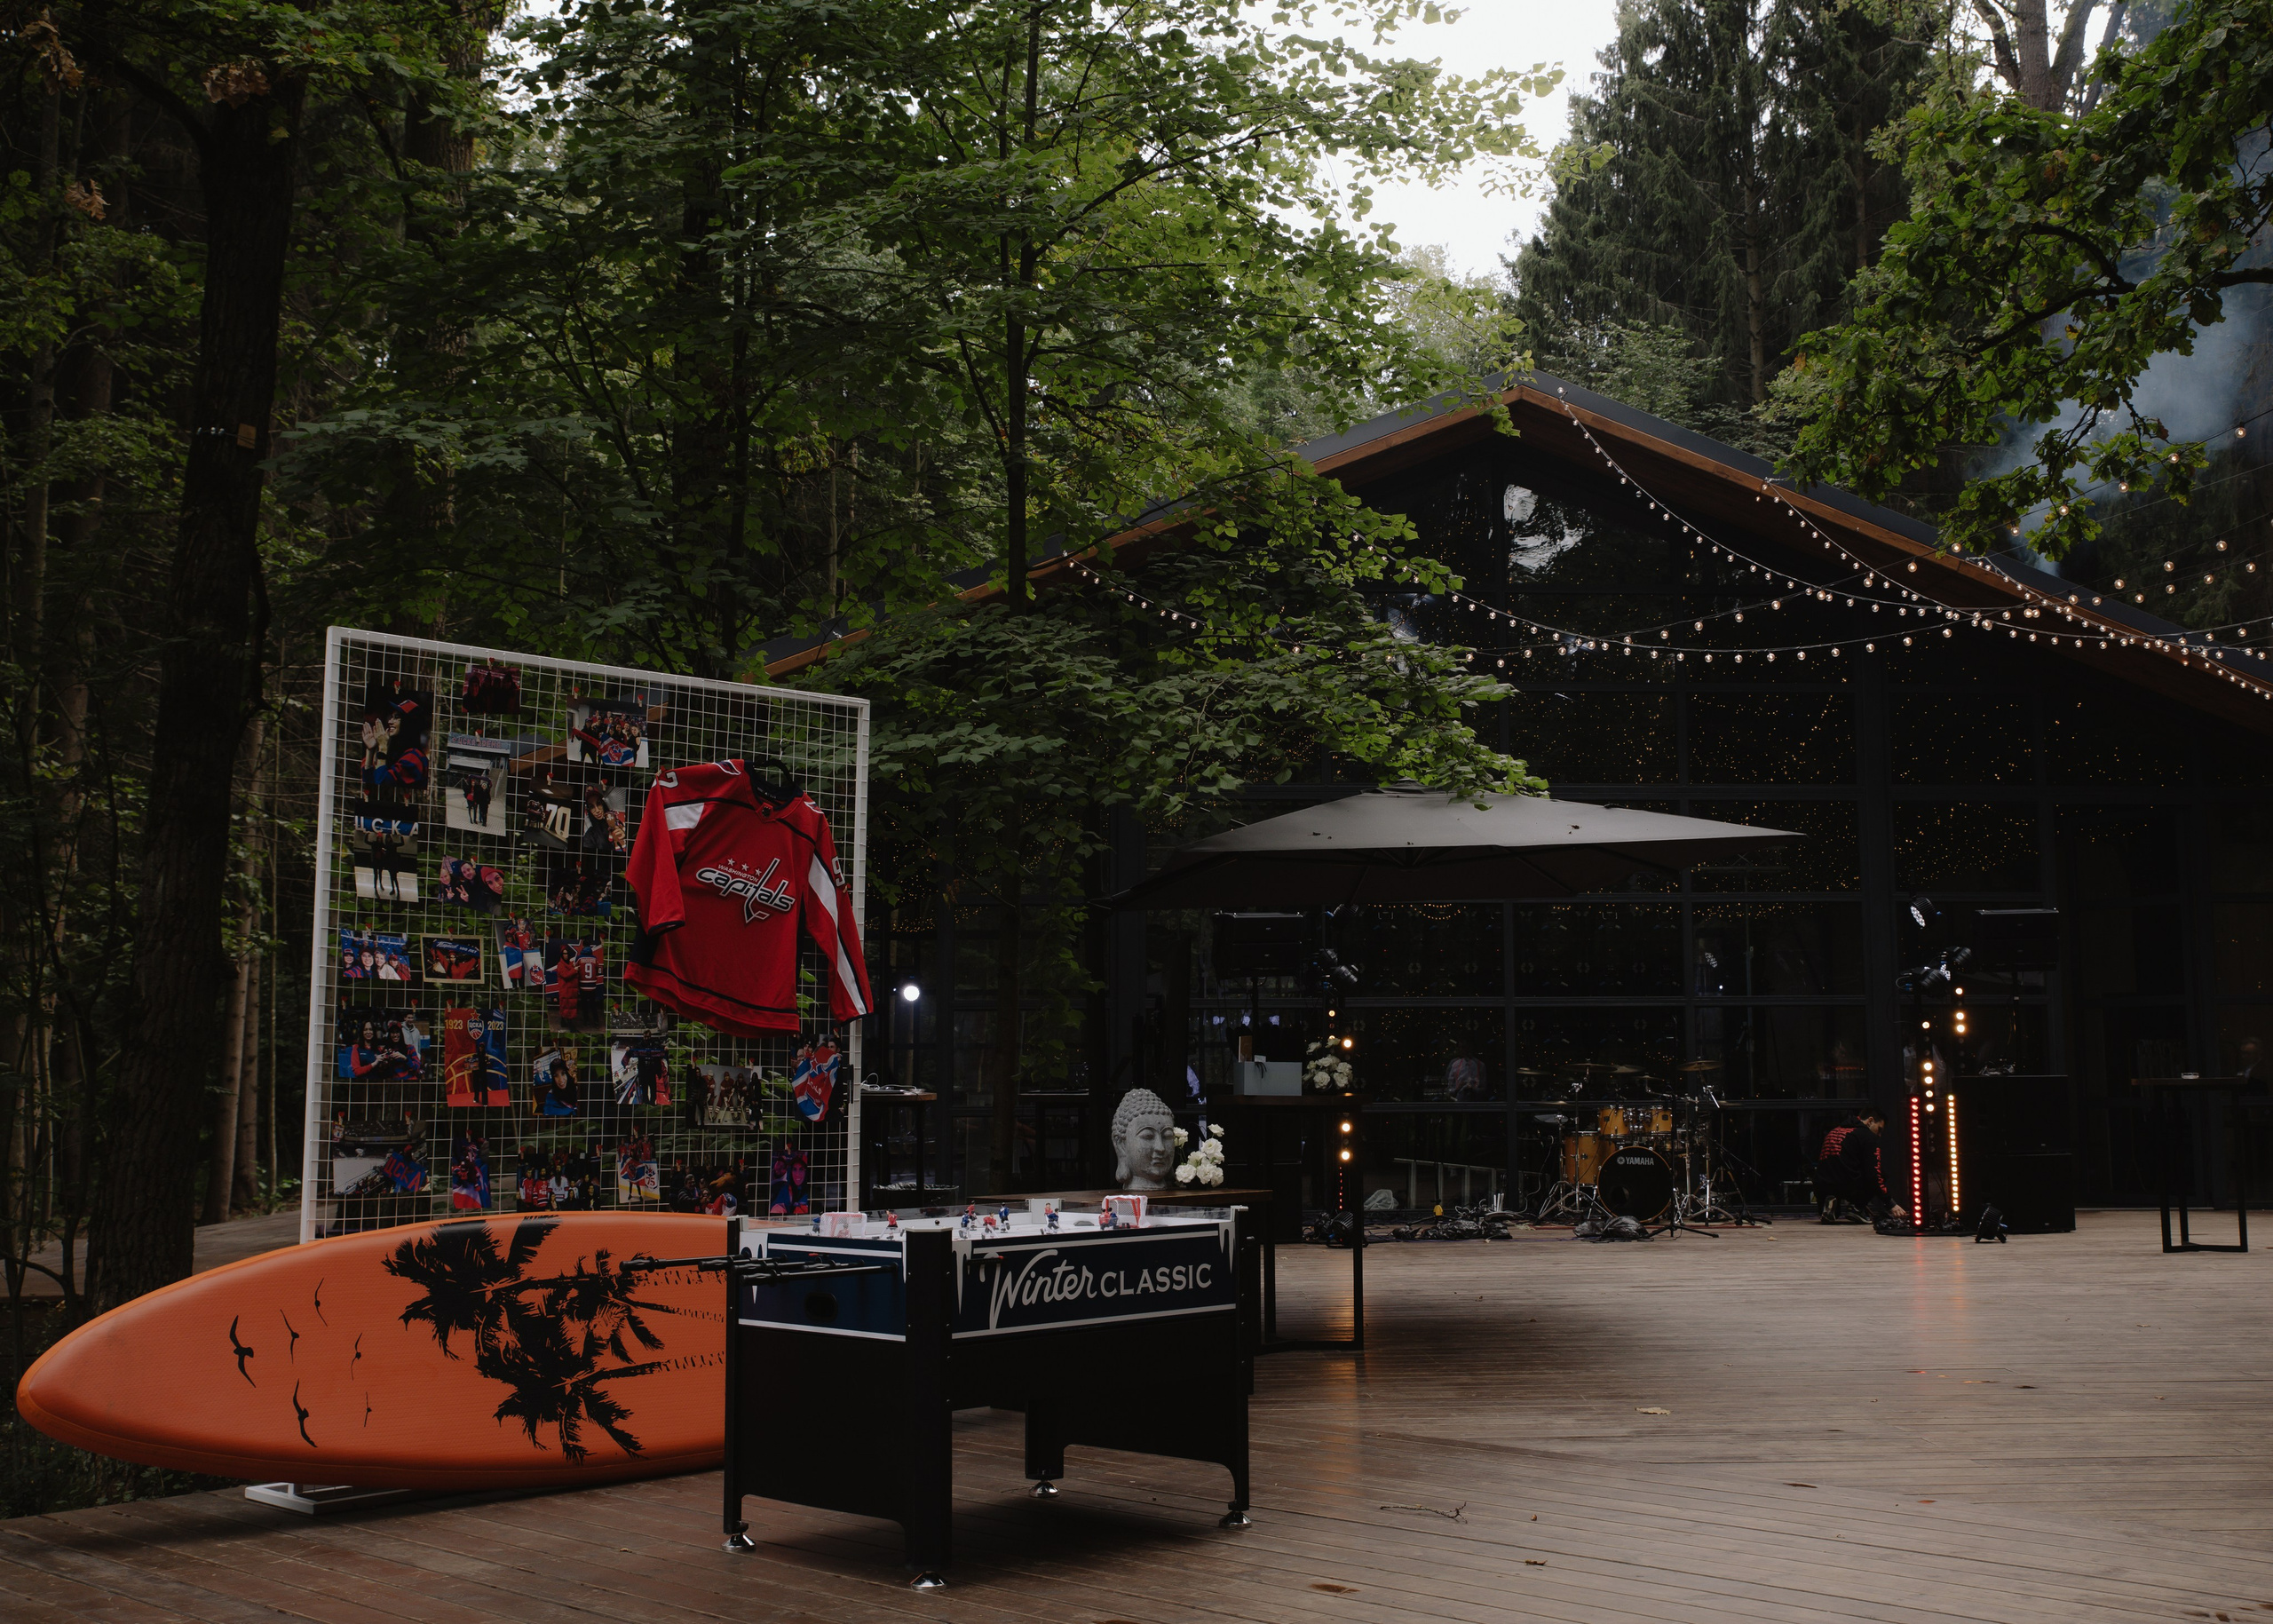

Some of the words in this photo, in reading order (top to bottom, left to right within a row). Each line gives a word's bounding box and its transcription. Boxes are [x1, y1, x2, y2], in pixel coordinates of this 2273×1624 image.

[354, 815, 419, 837] ЦСКА
[545, 804, 571, 839] 70
[717, 864, 759, 883] WASHINGTON
[584, 963, 594, 979] 9
[445, 1018, 463, 1030] 1923
[487, 1021, 504, 1031] 2023
[1625, 1156, 1655, 1166] YAMAHA
[384, 1156, 421, 1192] ЦСКА
[645, 1176, 656, 1186] 75
[979, 1249, 1097, 1329] Winter
[1099, 1263, 1213, 1298] CLASSIC
